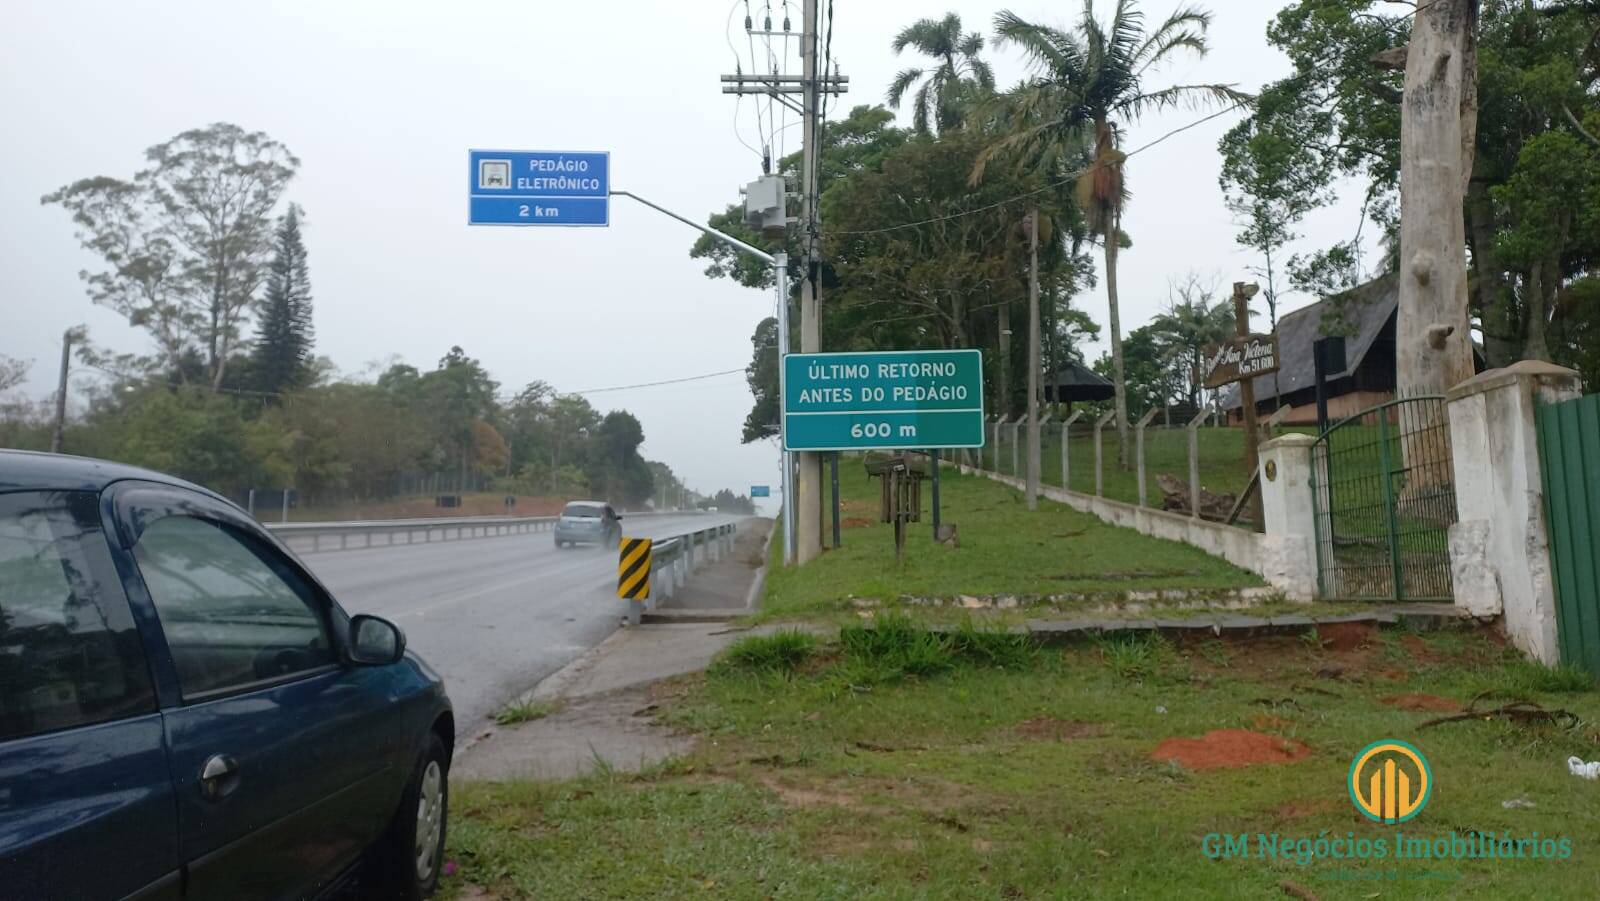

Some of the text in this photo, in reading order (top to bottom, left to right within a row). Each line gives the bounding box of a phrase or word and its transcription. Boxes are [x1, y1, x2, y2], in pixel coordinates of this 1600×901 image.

[530, 156, 588, 172] PEDÁGIO
[517, 176, 600, 190] ELETRÔNICO
[519, 205, 559, 217] 2 km
[808, 360, 956, 380] ÚLTIMO RETORNO
[799, 381, 968, 403] ANTES DO PEDÁGIO
[851, 423, 917, 438] 600 m
